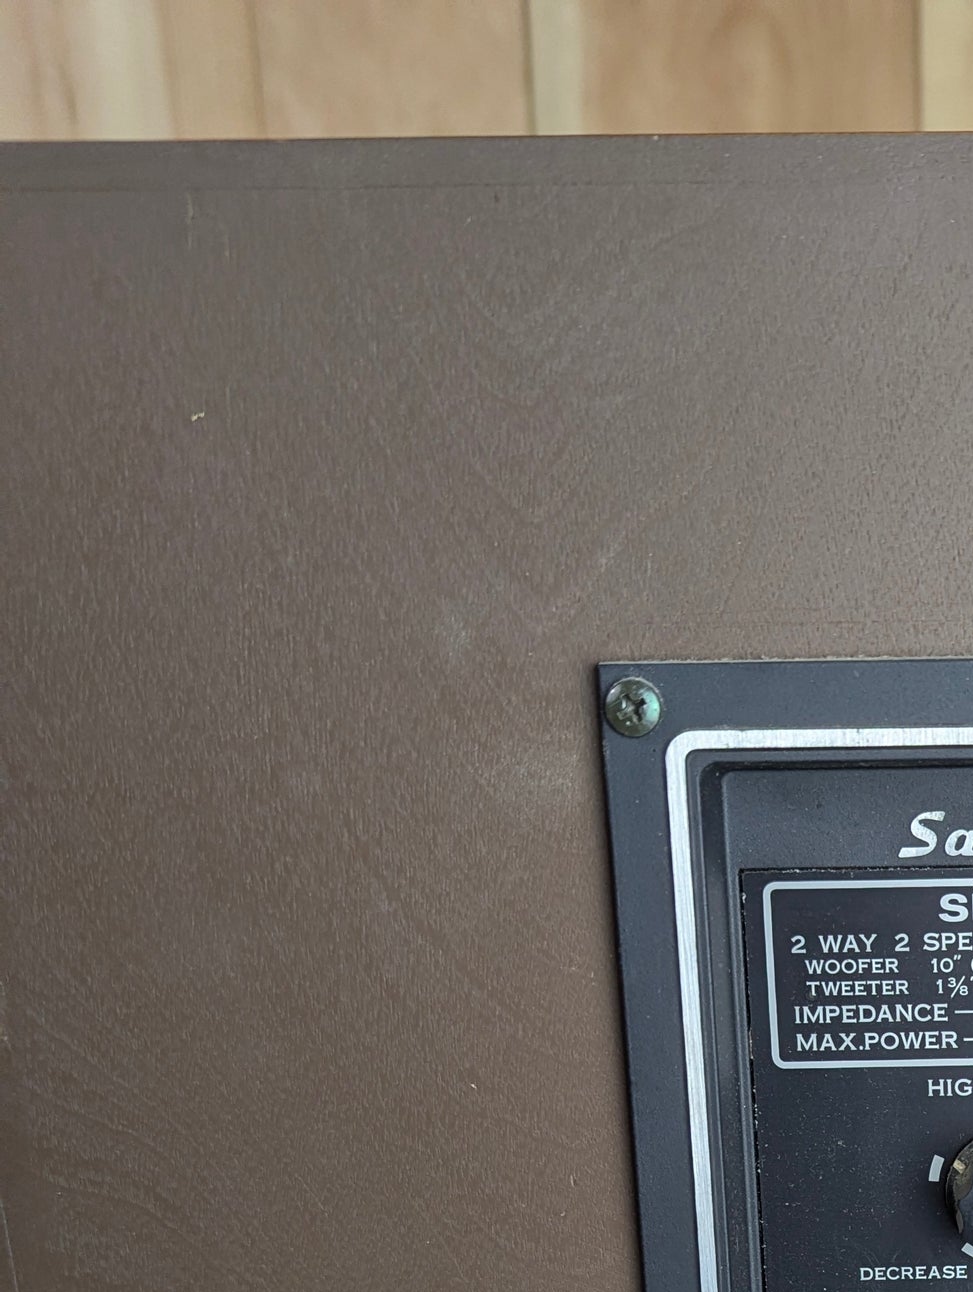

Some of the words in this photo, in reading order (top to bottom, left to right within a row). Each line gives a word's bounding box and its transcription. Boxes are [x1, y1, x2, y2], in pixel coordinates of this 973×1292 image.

[790, 935, 807, 954] 2
[818, 934, 877, 953] WAY
[894, 933, 910, 952] 2
[805, 957, 899, 976] WOOFER
[806, 979, 909, 997] TWEETER
[794, 1003, 949, 1024] IMPEDANCE
[796, 1031, 959, 1052] MAX.POWER
[859, 1265, 968, 1281] DECREASE
